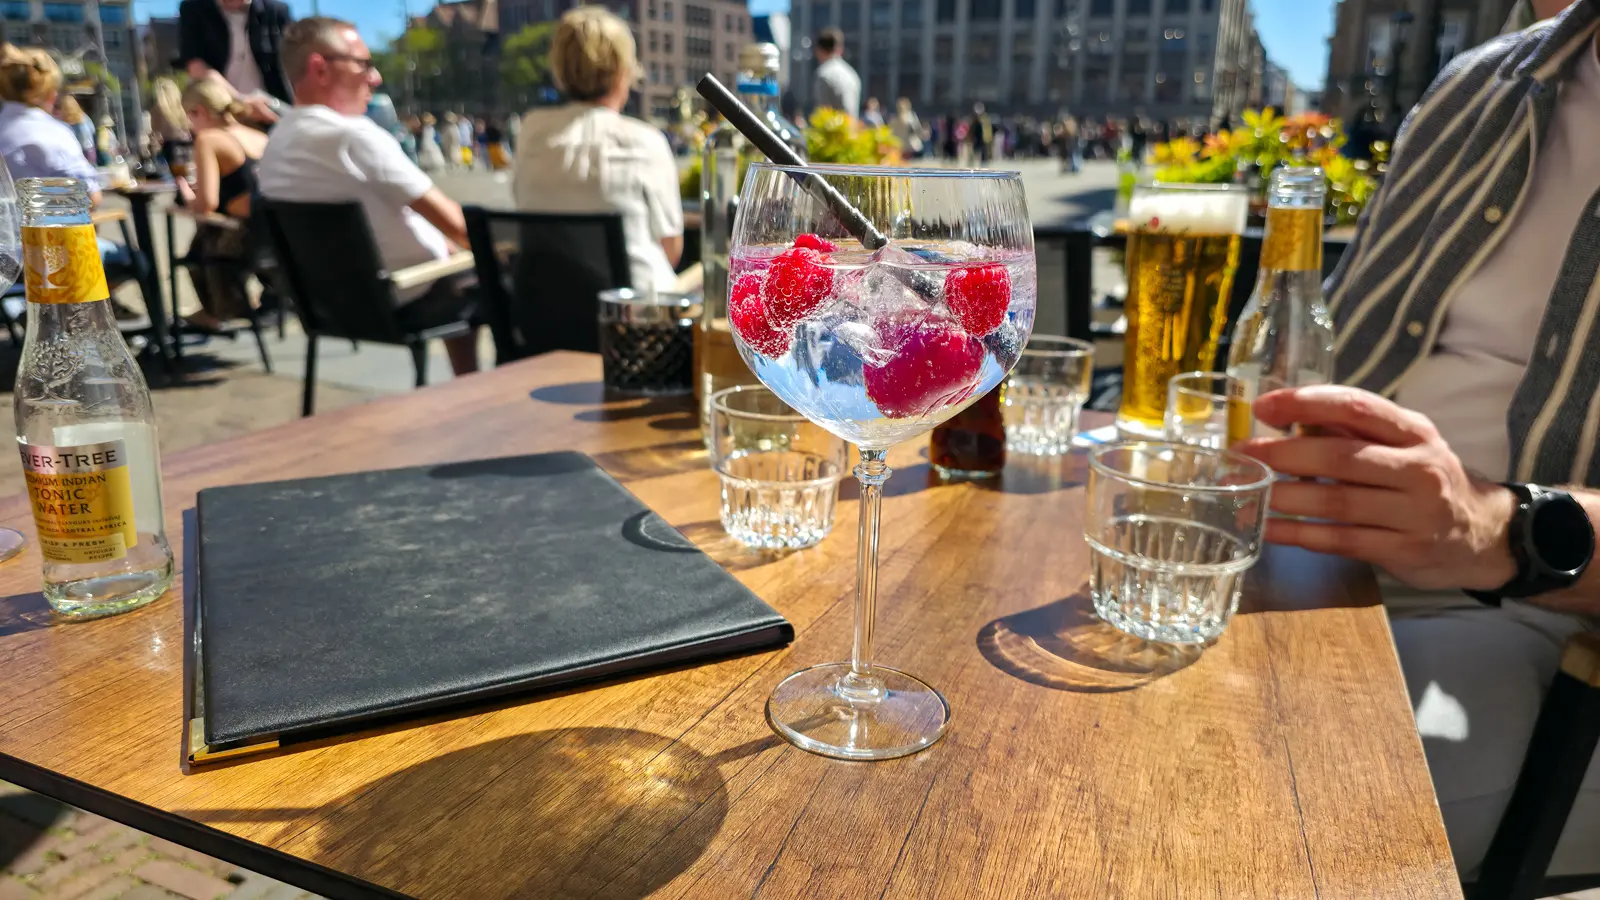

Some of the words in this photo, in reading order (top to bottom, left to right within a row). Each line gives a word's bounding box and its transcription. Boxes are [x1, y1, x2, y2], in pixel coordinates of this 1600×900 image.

[62, 474, 107, 486] INDIAN
[35, 488, 85, 501] TONIC
[37, 503, 92, 515] WATER
[99, 520, 127, 532] AFRICA
